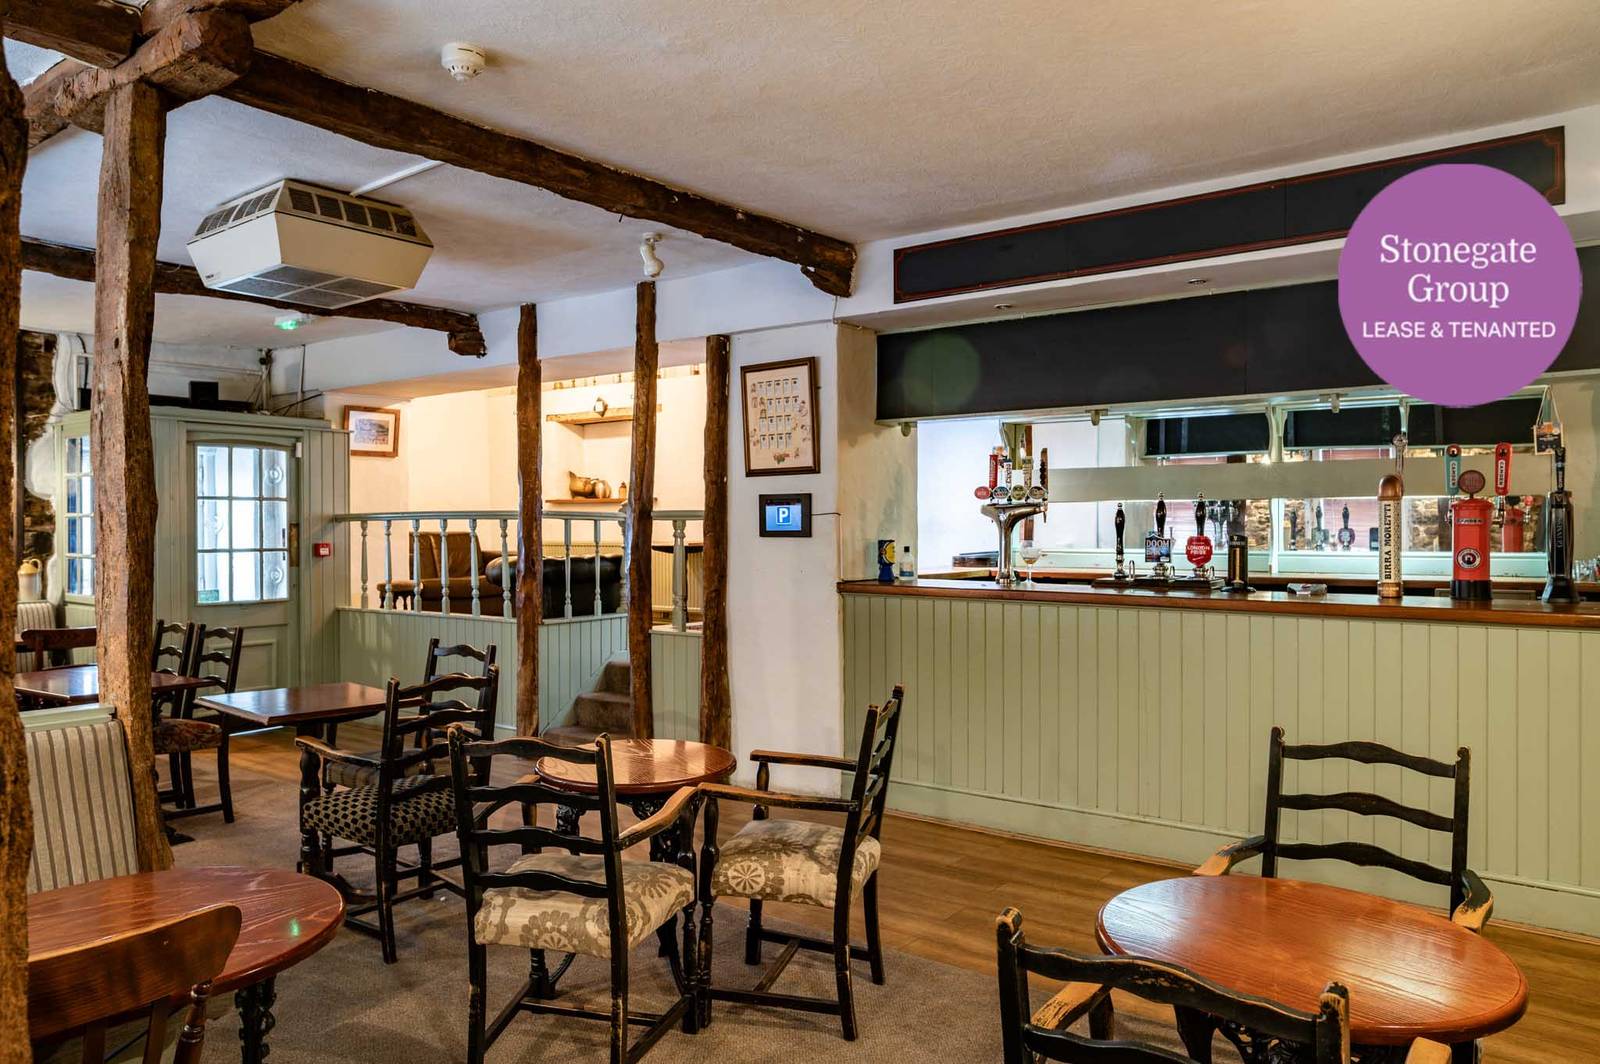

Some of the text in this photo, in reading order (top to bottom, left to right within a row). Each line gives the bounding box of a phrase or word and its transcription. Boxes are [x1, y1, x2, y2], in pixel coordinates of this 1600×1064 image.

[779, 508, 788, 523] P
[1146, 539, 1169, 547] DOOM
[1384, 503, 1392, 580] BIRRA MORETTI
